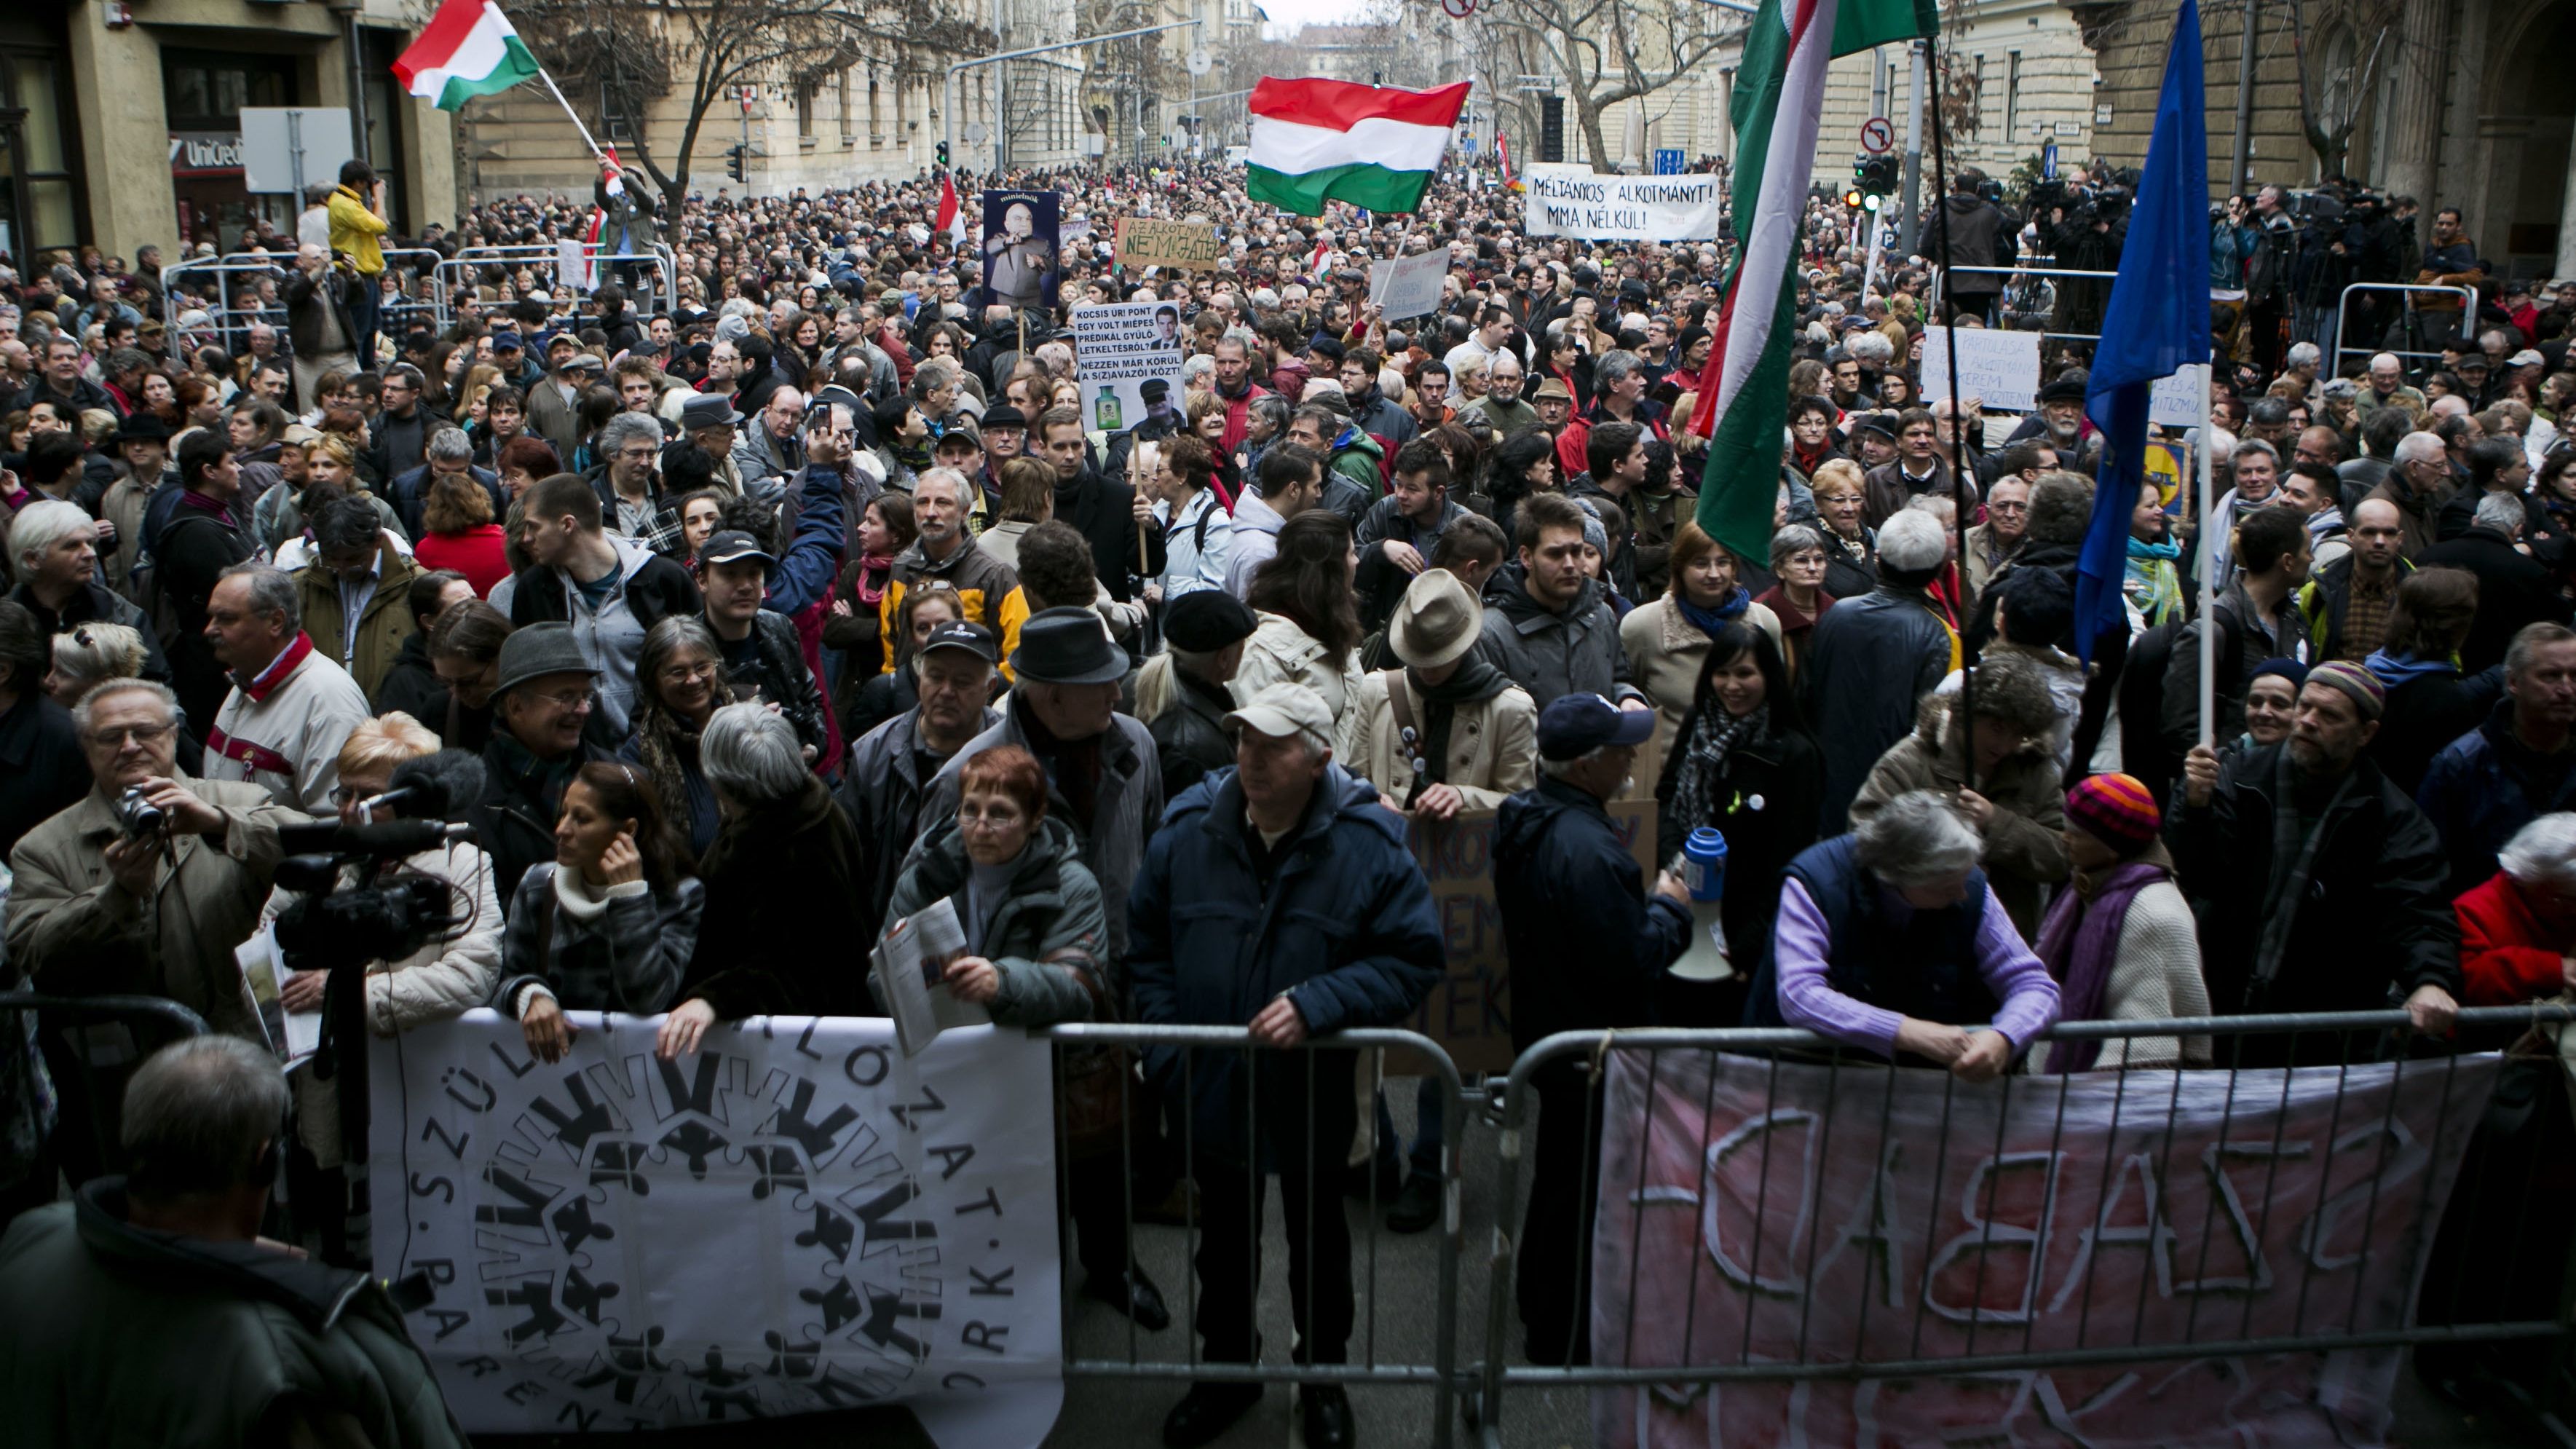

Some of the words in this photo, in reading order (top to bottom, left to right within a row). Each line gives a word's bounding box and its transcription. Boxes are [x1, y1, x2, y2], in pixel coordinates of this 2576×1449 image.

[1534, 175, 1604, 202] MÉLTÁNYOS
[1619, 181, 1712, 204] ALKOTMÁNYT!
[1547, 206, 1580, 229] MMA
[1587, 206, 1646, 230] NÉLKÜL!
[1129, 221, 1147, 234] AZ
[1126, 234, 1172, 258] NEM
[1077, 310, 1109, 319] KOCSIS
[1129, 307, 1151, 316] PONT
[1078, 323, 1097, 331] EGY
[1098, 321, 1120, 330] VOLT
[1123, 318, 1154, 328] MIÉPES
[1079, 332, 1121, 342] PRÉDIKÁL
[1081, 360, 1119, 370] NÉZZEN
[1123, 358, 1143, 368] MÁR
[1147, 356, 1180, 366] KÖRÜL
[1092, 369, 1147, 381] S(Z)AVAZÓI
[1151, 367, 1180, 376] KÖZT!
